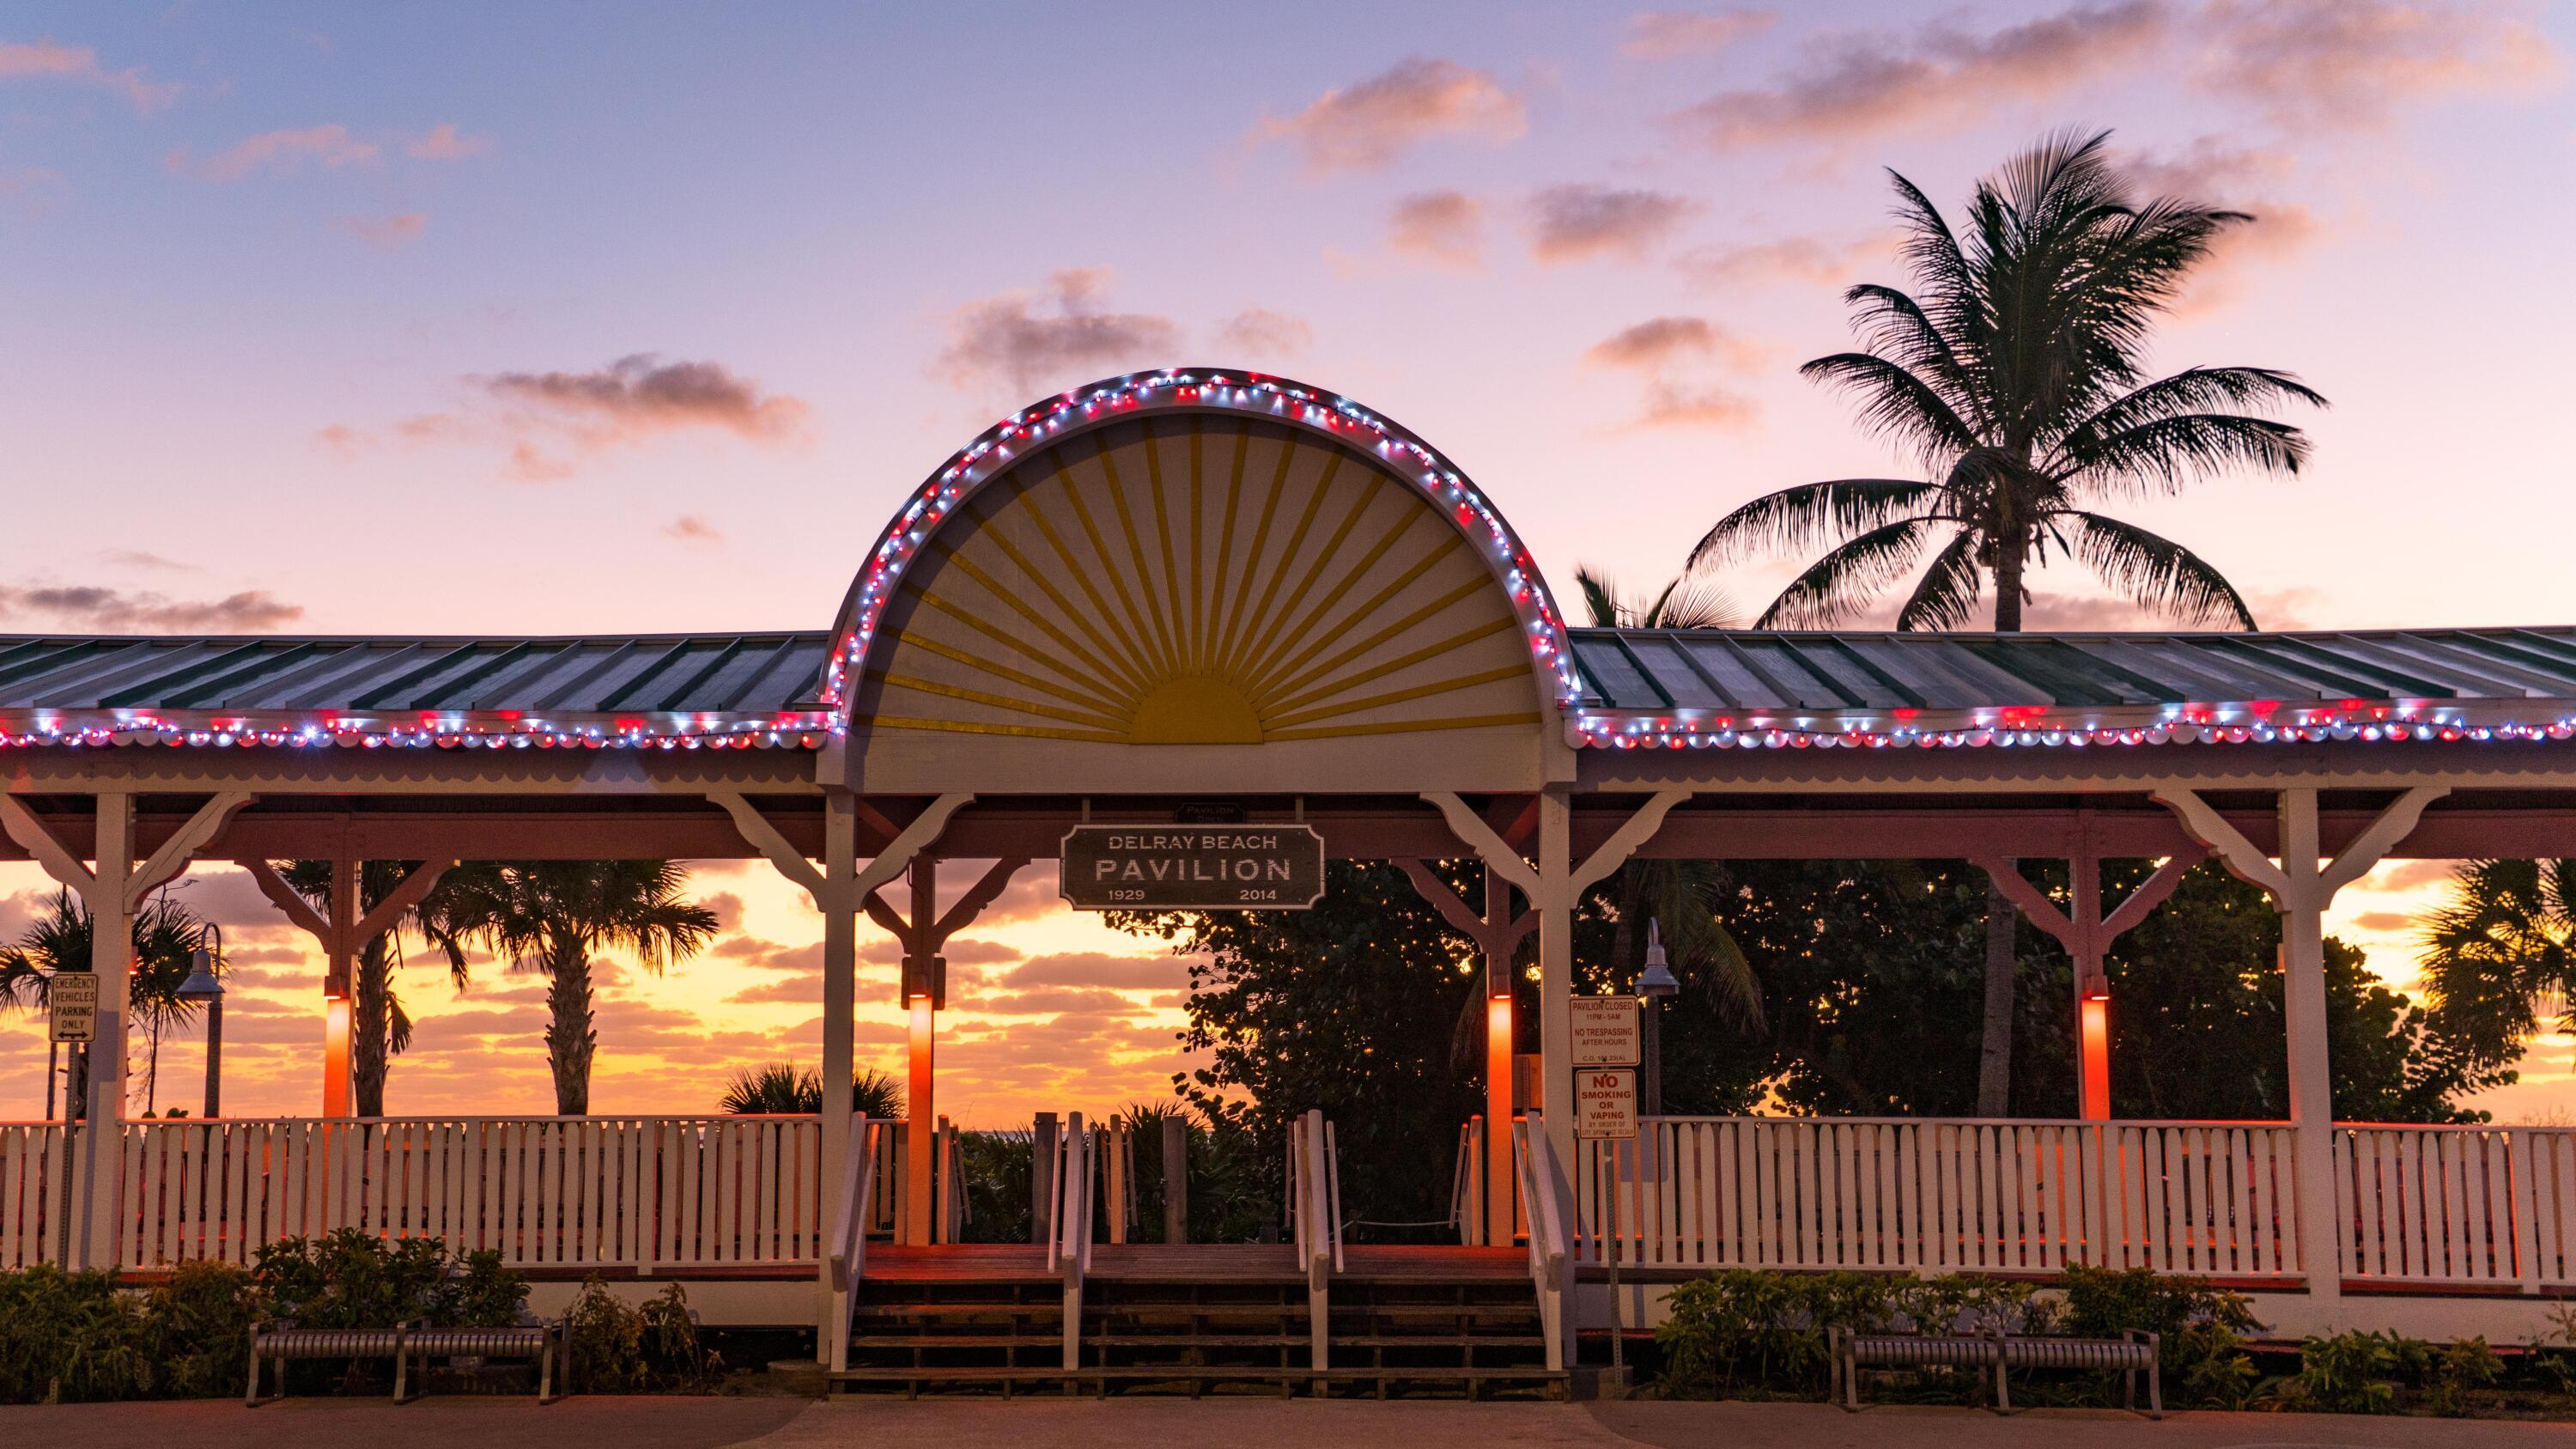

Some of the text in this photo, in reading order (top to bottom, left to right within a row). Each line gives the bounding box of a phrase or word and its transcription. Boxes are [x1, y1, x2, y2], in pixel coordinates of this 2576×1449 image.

[1109, 836, 1277, 849] DELRAY BEACH
[1095, 859, 1291, 881] PAVILION
[1108, 890, 1277, 900] 1929 2014
[55, 978, 95, 989] EMERGENCY
[55, 992, 95, 1002] VEHICLES
[1572, 1002, 1633, 1011] PAVILION CLOSED
[55, 1007, 92, 1017] PARKING
[61, 1020, 85, 1029] ONLY
[1575, 1027, 1633, 1037] NO TRESPASSING
[1593, 1075, 1619, 1088] NO
[1581, 1090, 1631, 1099] SMOKING
